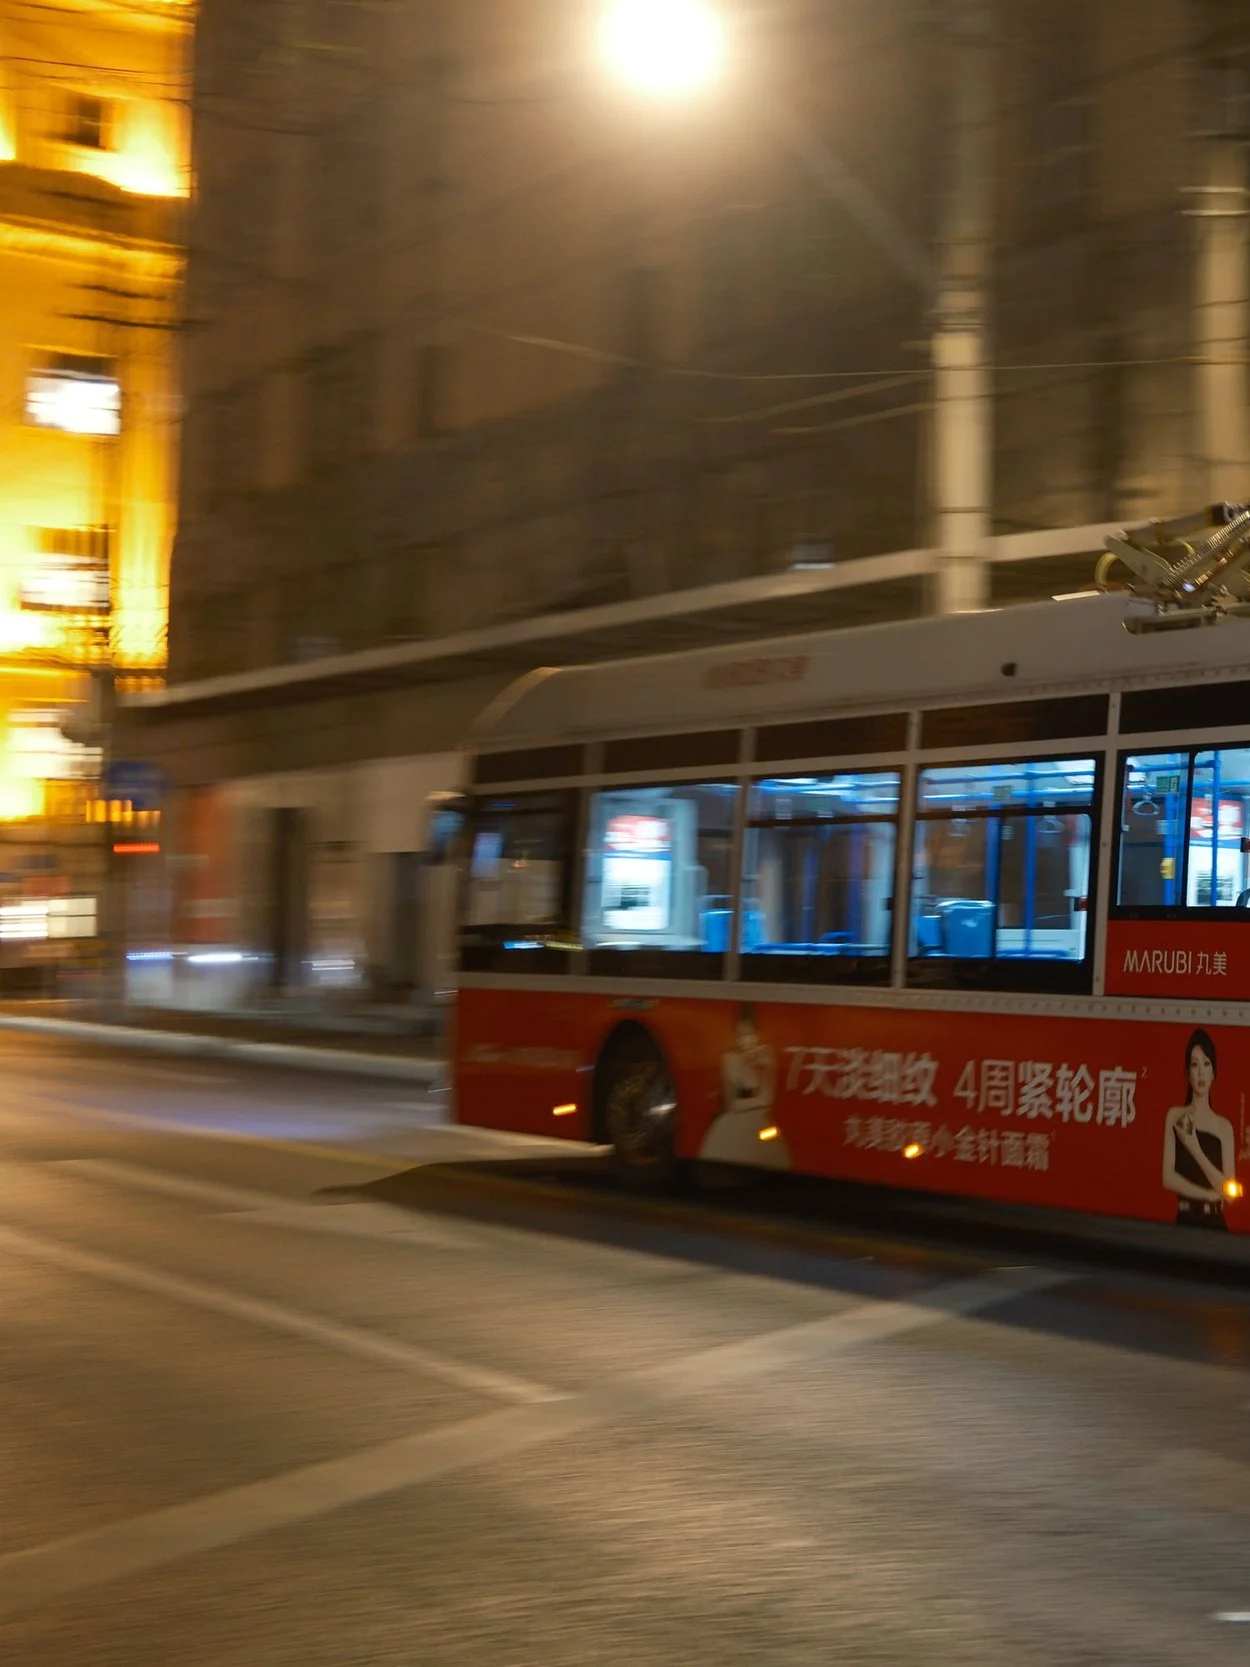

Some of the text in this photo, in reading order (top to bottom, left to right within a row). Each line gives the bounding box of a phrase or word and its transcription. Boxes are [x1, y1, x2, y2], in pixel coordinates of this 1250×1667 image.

[1123, 949, 1228, 976] MARUBI 丸美
[953, 1058, 1137, 1129] 4周紧轮廓
